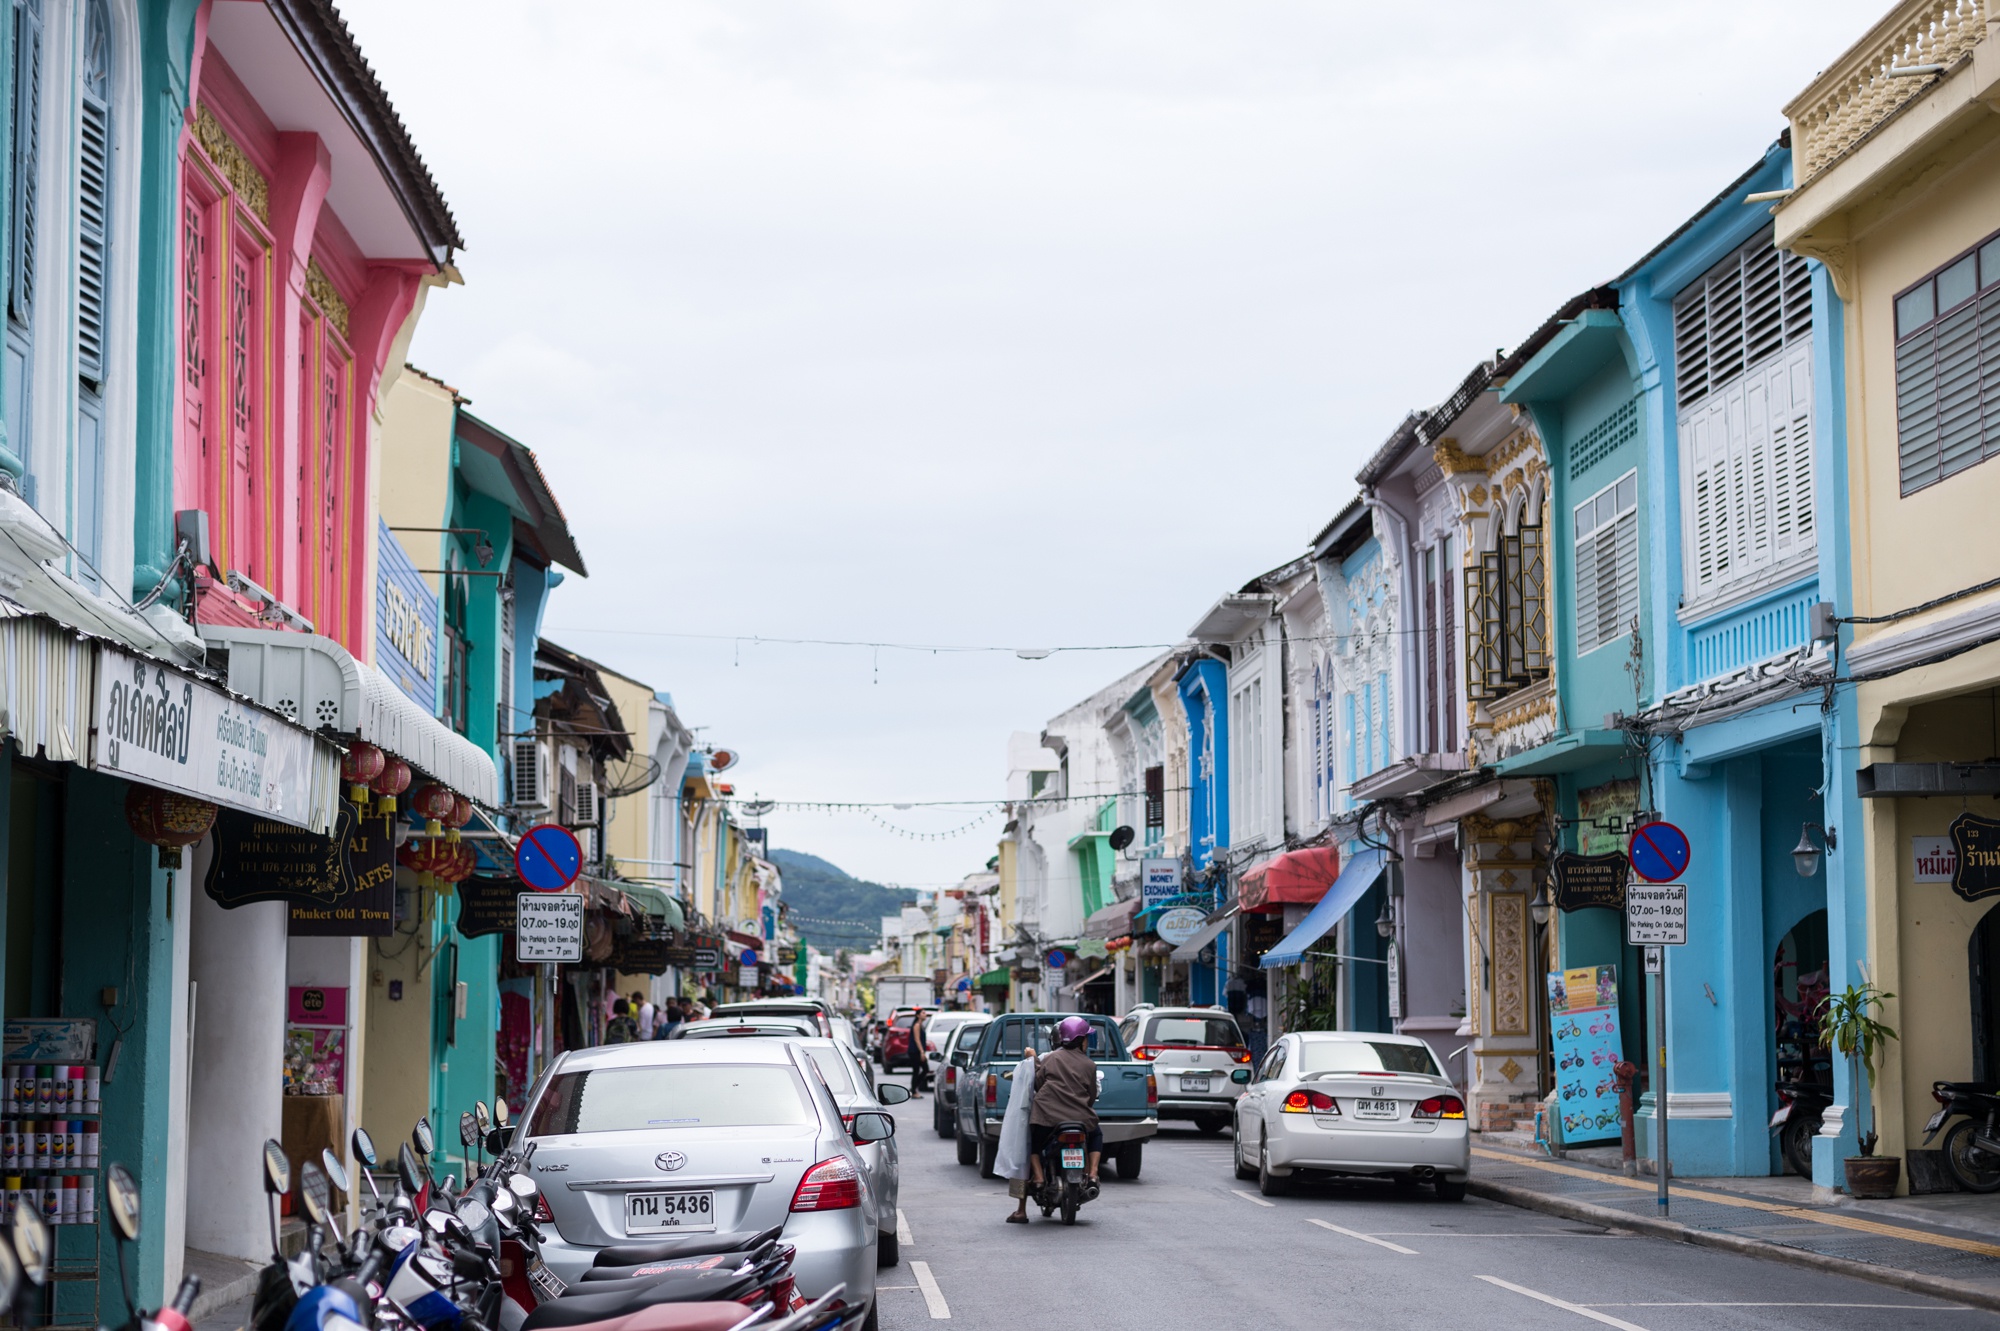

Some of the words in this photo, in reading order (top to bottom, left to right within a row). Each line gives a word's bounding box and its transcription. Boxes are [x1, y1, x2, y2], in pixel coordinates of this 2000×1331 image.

[1967, 829, 1979, 838] 133
[356, 862, 393, 892] AFTS
[1150, 874, 1174, 883] MONEY
[1144, 885, 1180, 895] EXCHANGE
[1629, 886, 1684, 900] ห้ามจอดวันคี่
[521, 898, 580, 917] ห้ามจอดวันคู่
[1630, 905, 1683, 916] 07.00-19.00
[292, 908, 332, 920] Phuket
[335, 908, 355, 920] Old
[360, 908, 390, 920] Town
[521, 917, 579, 929] 07.00-19.00
[1637, 921, 1654, 929] Parking
[1674, 921, 1684, 930] Day
[520, 935, 528, 943] No
[529, 935, 547, 944] Parking
[548, 935, 556, 943] On
[557, 935, 568, 943] Even
[570, 935, 579, 944] Day
[1636, 931, 1641, 939] 7
[1661, 931, 1667, 939] 7
[528, 946, 533, 955] 7
[556, 946, 561, 955] 7
[562, 948, 572, 956] pm
[1374, 1101, 1396, 1111] 4813
[537, 1164, 569, 1172] VIOS
[632, 1197, 658, 1216] กน
[664, 1195, 710, 1215] 5436
